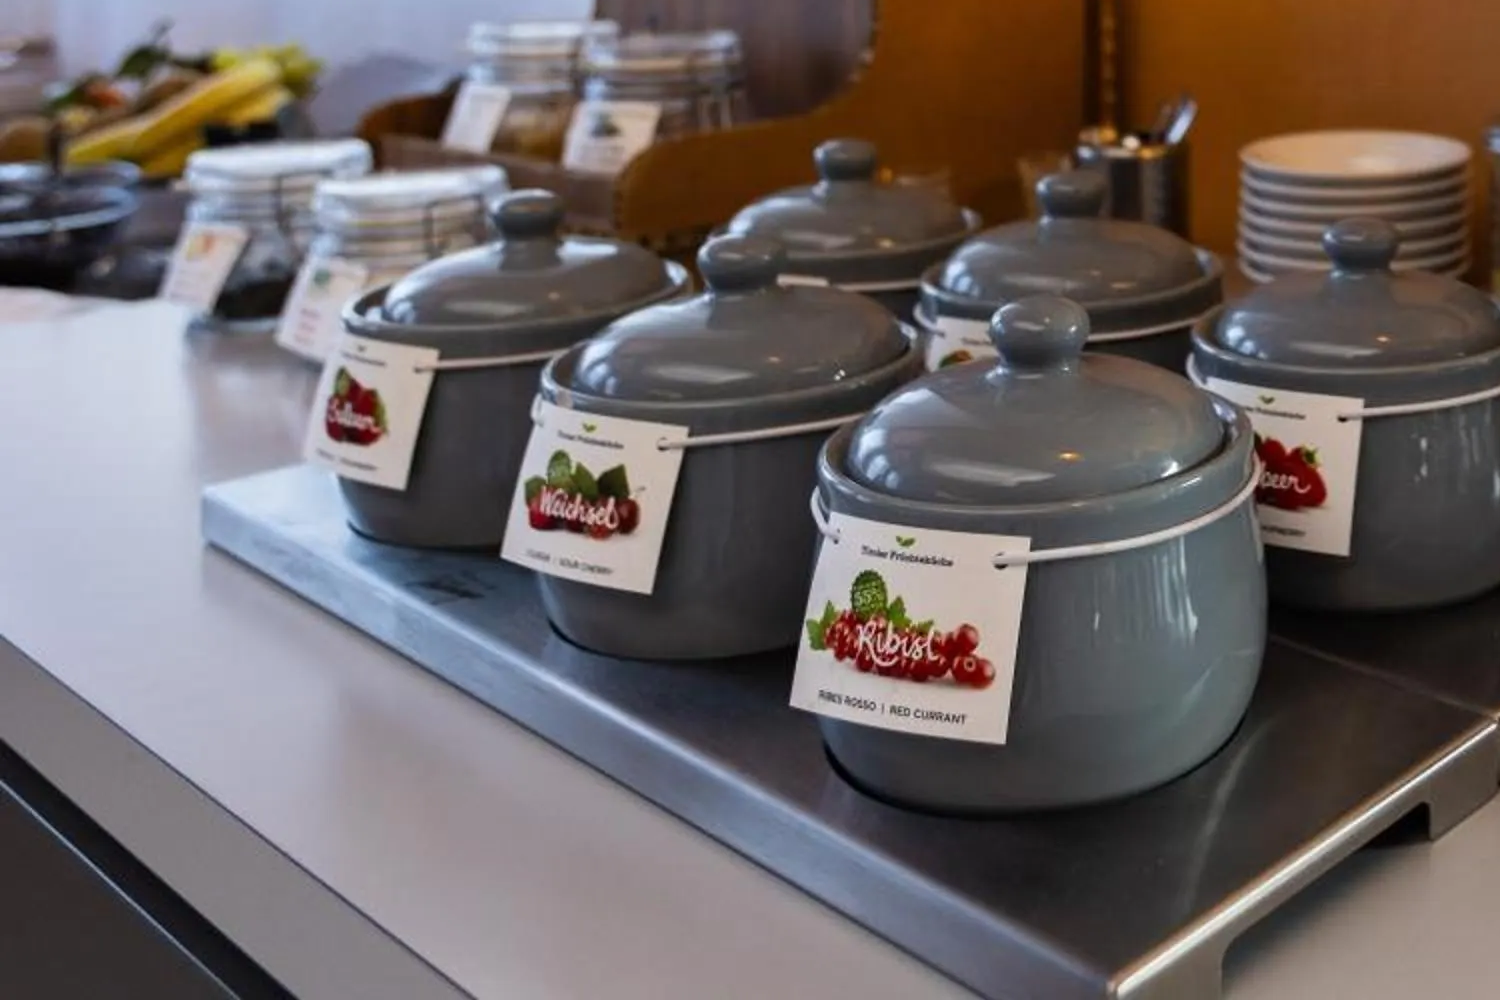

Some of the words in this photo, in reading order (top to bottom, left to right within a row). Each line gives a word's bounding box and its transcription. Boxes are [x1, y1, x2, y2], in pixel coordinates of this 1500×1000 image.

[540, 486, 619, 529] Weichsel
[843, 695, 877, 712] ROSSO
[889, 704, 911, 718] RED
[913, 708, 968, 726] CURRANT
